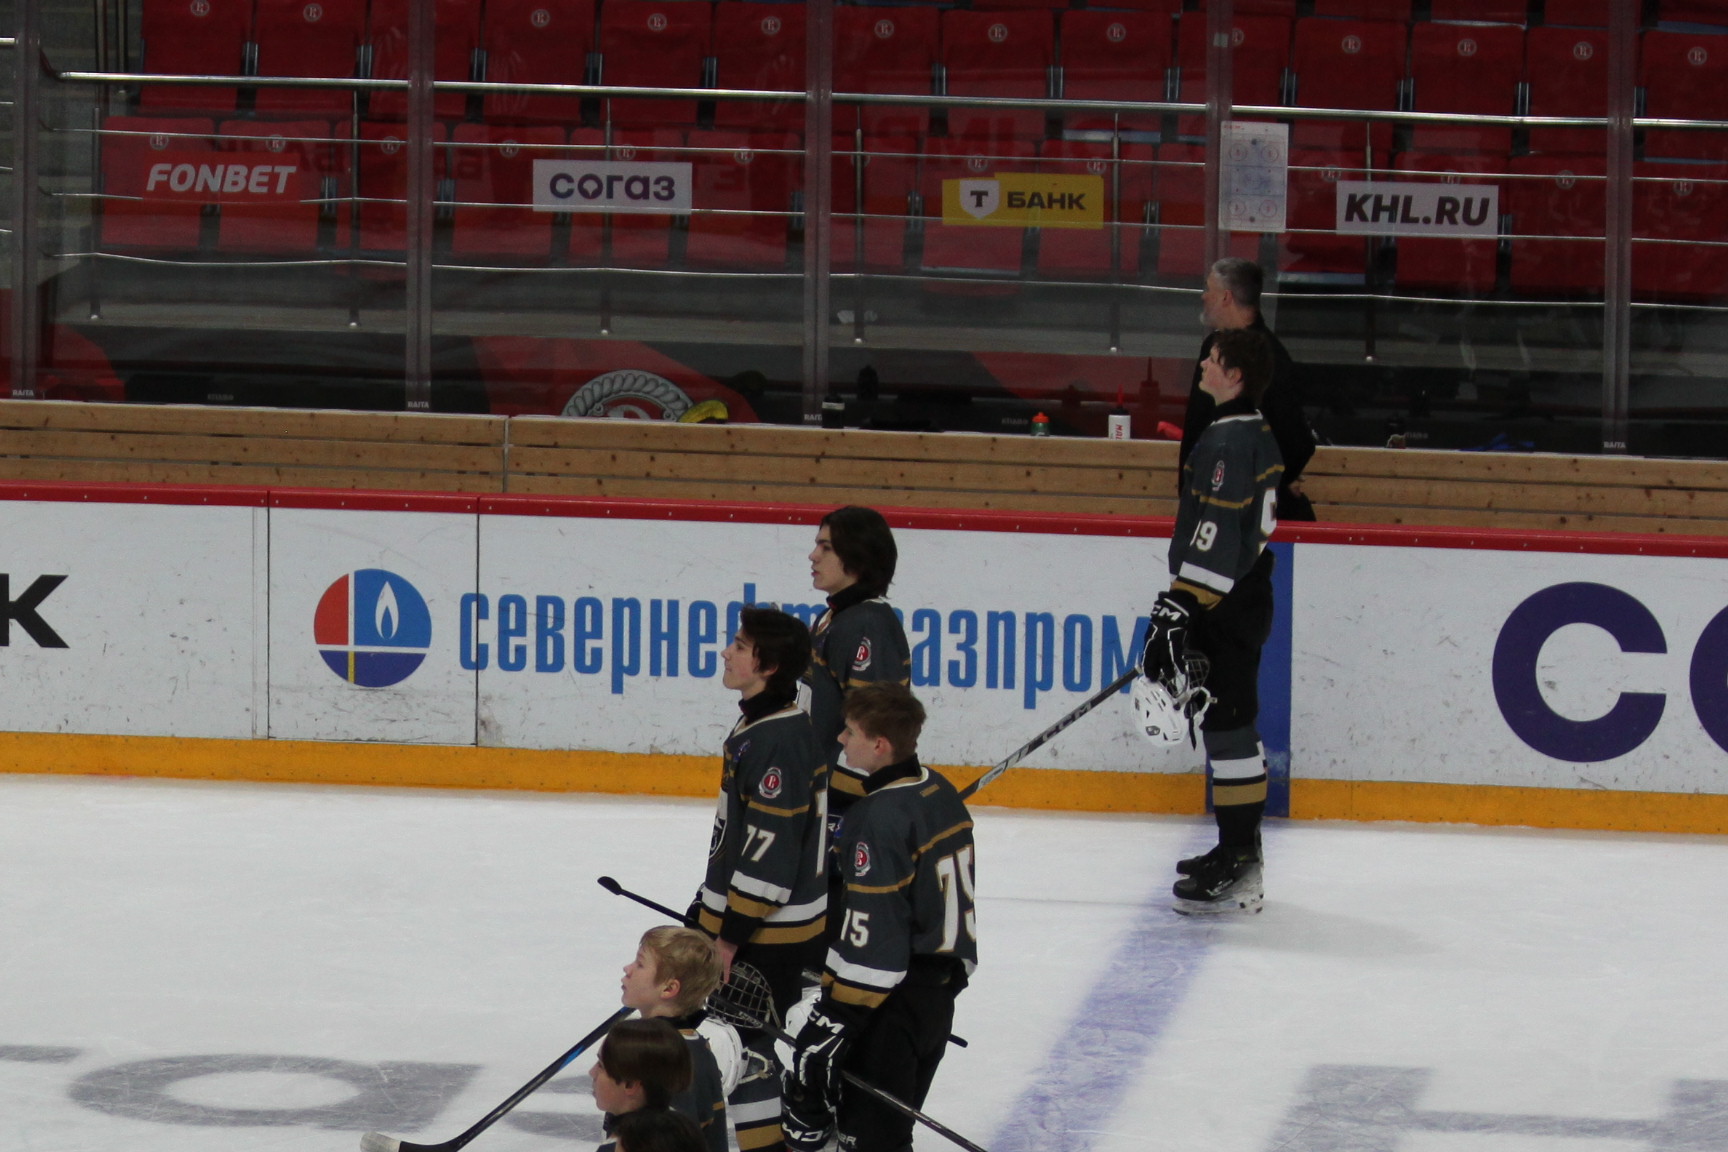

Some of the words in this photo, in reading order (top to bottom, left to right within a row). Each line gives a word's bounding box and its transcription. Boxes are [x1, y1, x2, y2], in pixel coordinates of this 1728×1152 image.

[145, 162, 298, 196] FONBET
[1007, 191, 1086, 211] БАНК
[1344, 193, 1490, 226] KHL.RU
